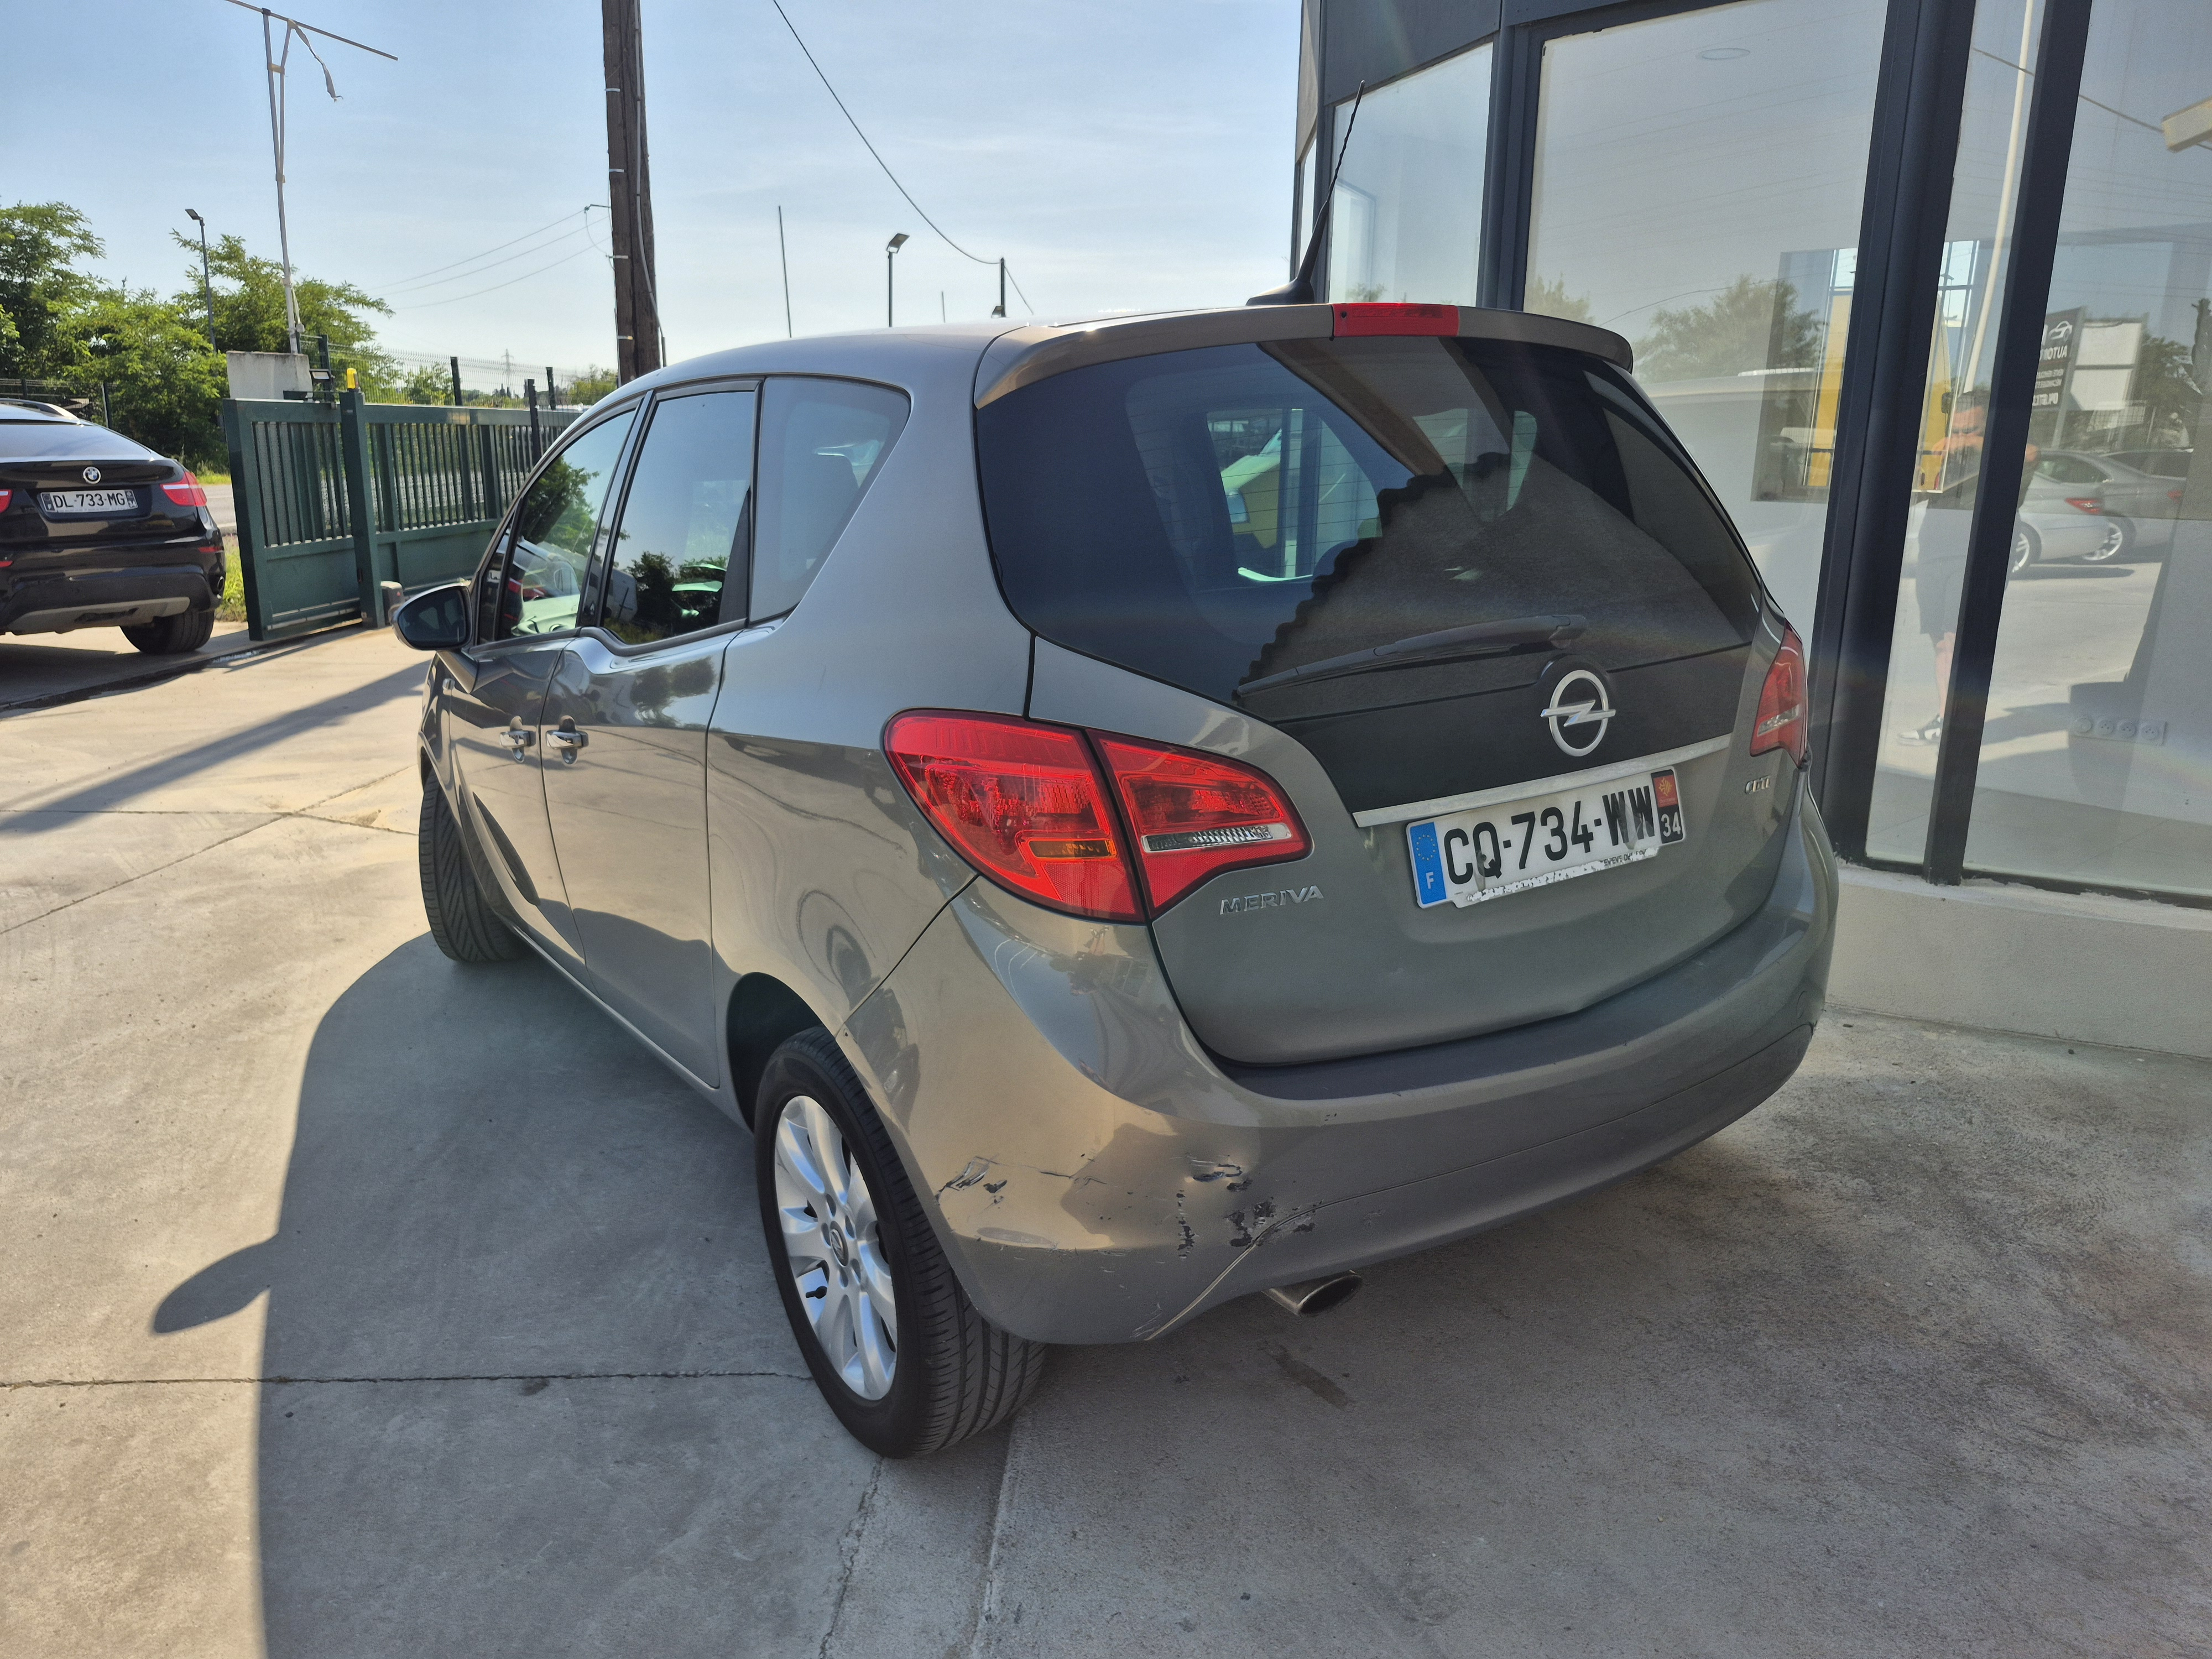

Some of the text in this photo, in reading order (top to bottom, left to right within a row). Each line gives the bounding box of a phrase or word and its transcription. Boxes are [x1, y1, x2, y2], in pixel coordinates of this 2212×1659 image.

[53, 493, 126, 508] DL-733-MG
[1444, 785, 1655, 885] CQ-734-WW
[1661, 812, 1681, 837] 34
[1426, 872, 1434, 889] F
[1219, 885, 1324, 915] MERIVA
